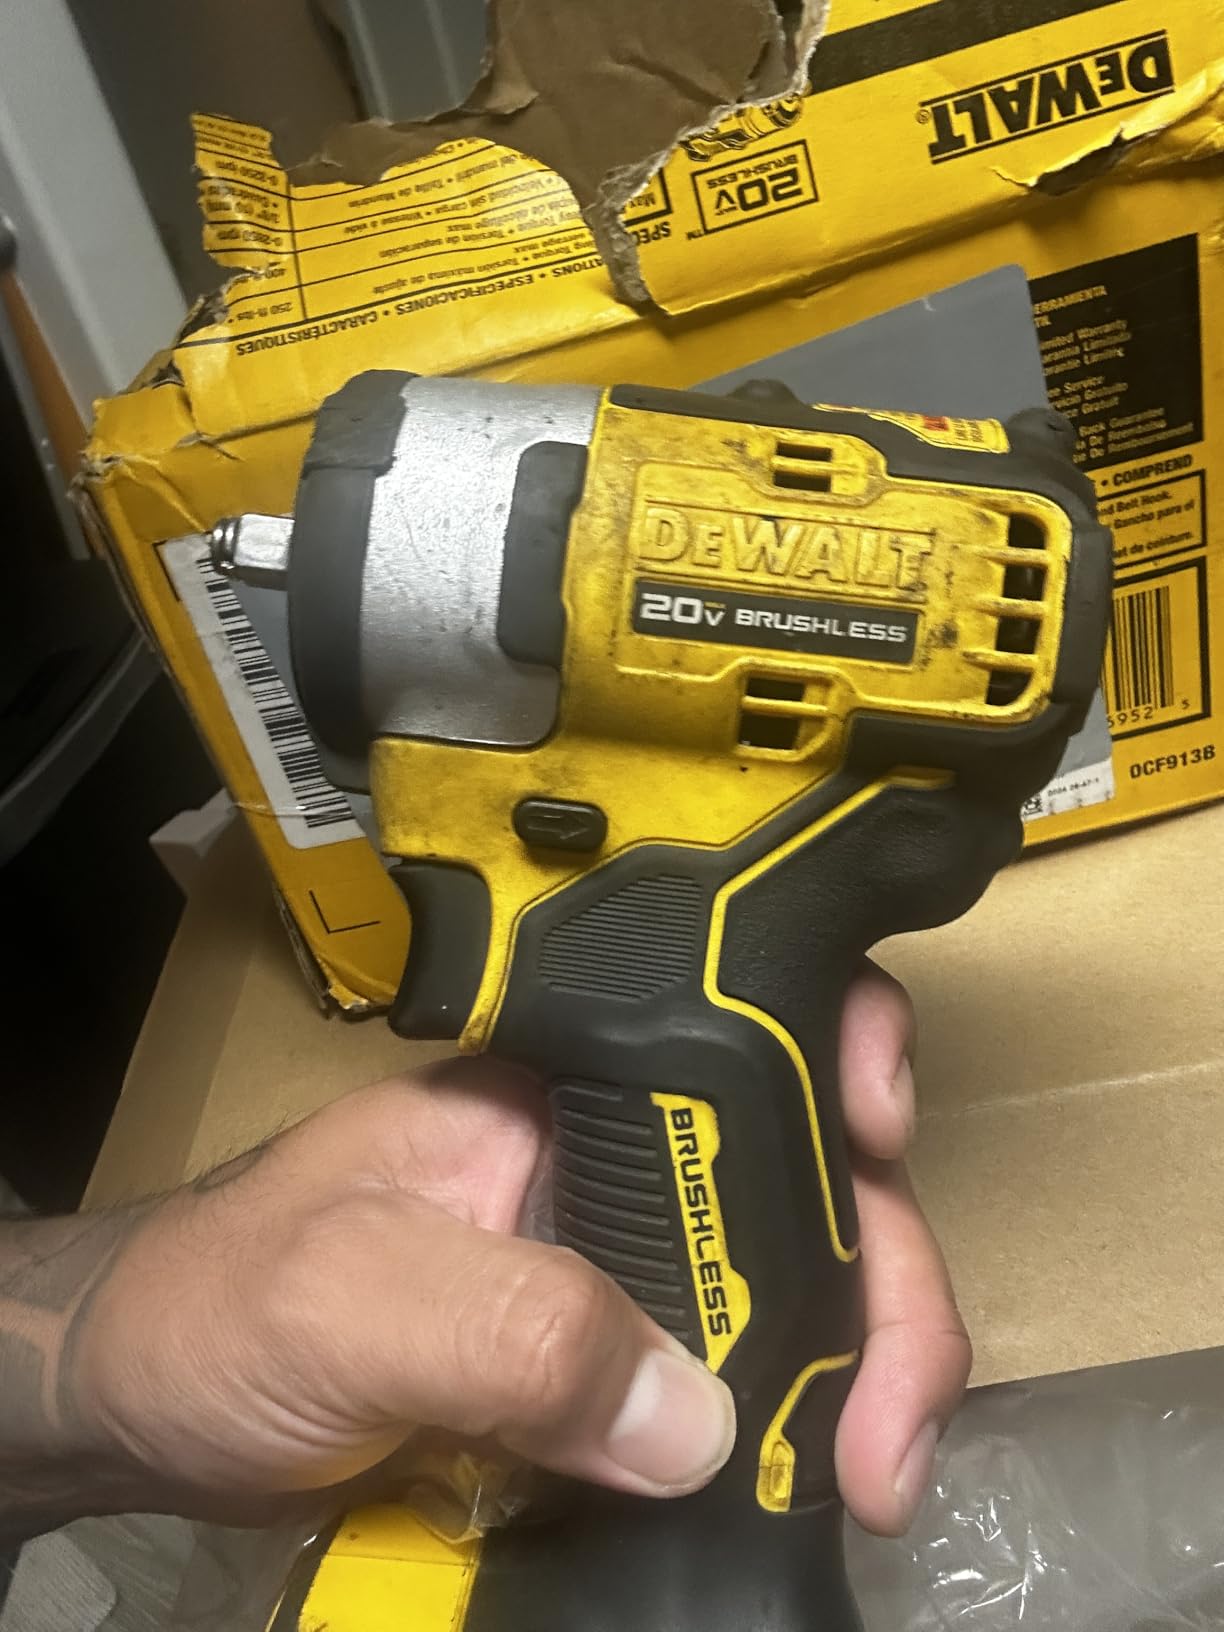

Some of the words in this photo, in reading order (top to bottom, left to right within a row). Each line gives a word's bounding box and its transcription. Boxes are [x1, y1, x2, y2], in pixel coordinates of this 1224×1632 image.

[928, 38, 1174, 157] DEWALT
[706, 154, 798, 189] BRUSHLESS
[444, 234, 459, 246] de
[512, 242, 539, 254] max
[531, 243, 572, 261] Torque
[394, 273, 534, 315] ESPECIFICACIONES
[409, 274, 425, 285] de
[236, 309, 378, 356] CARACTÉRISTIQUES
[1063, 376, 1105, 393] Service
[1113, 454, 1193, 487] COMPREND
[1116, 498, 1139, 512] Belt
[1157, 505, 1182, 520] para
[638, 507, 932, 592] DEWALT
[735, 608, 908, 643] BRUSHLESS
[670, 1107, 731, 1336] BRUSHLESS
